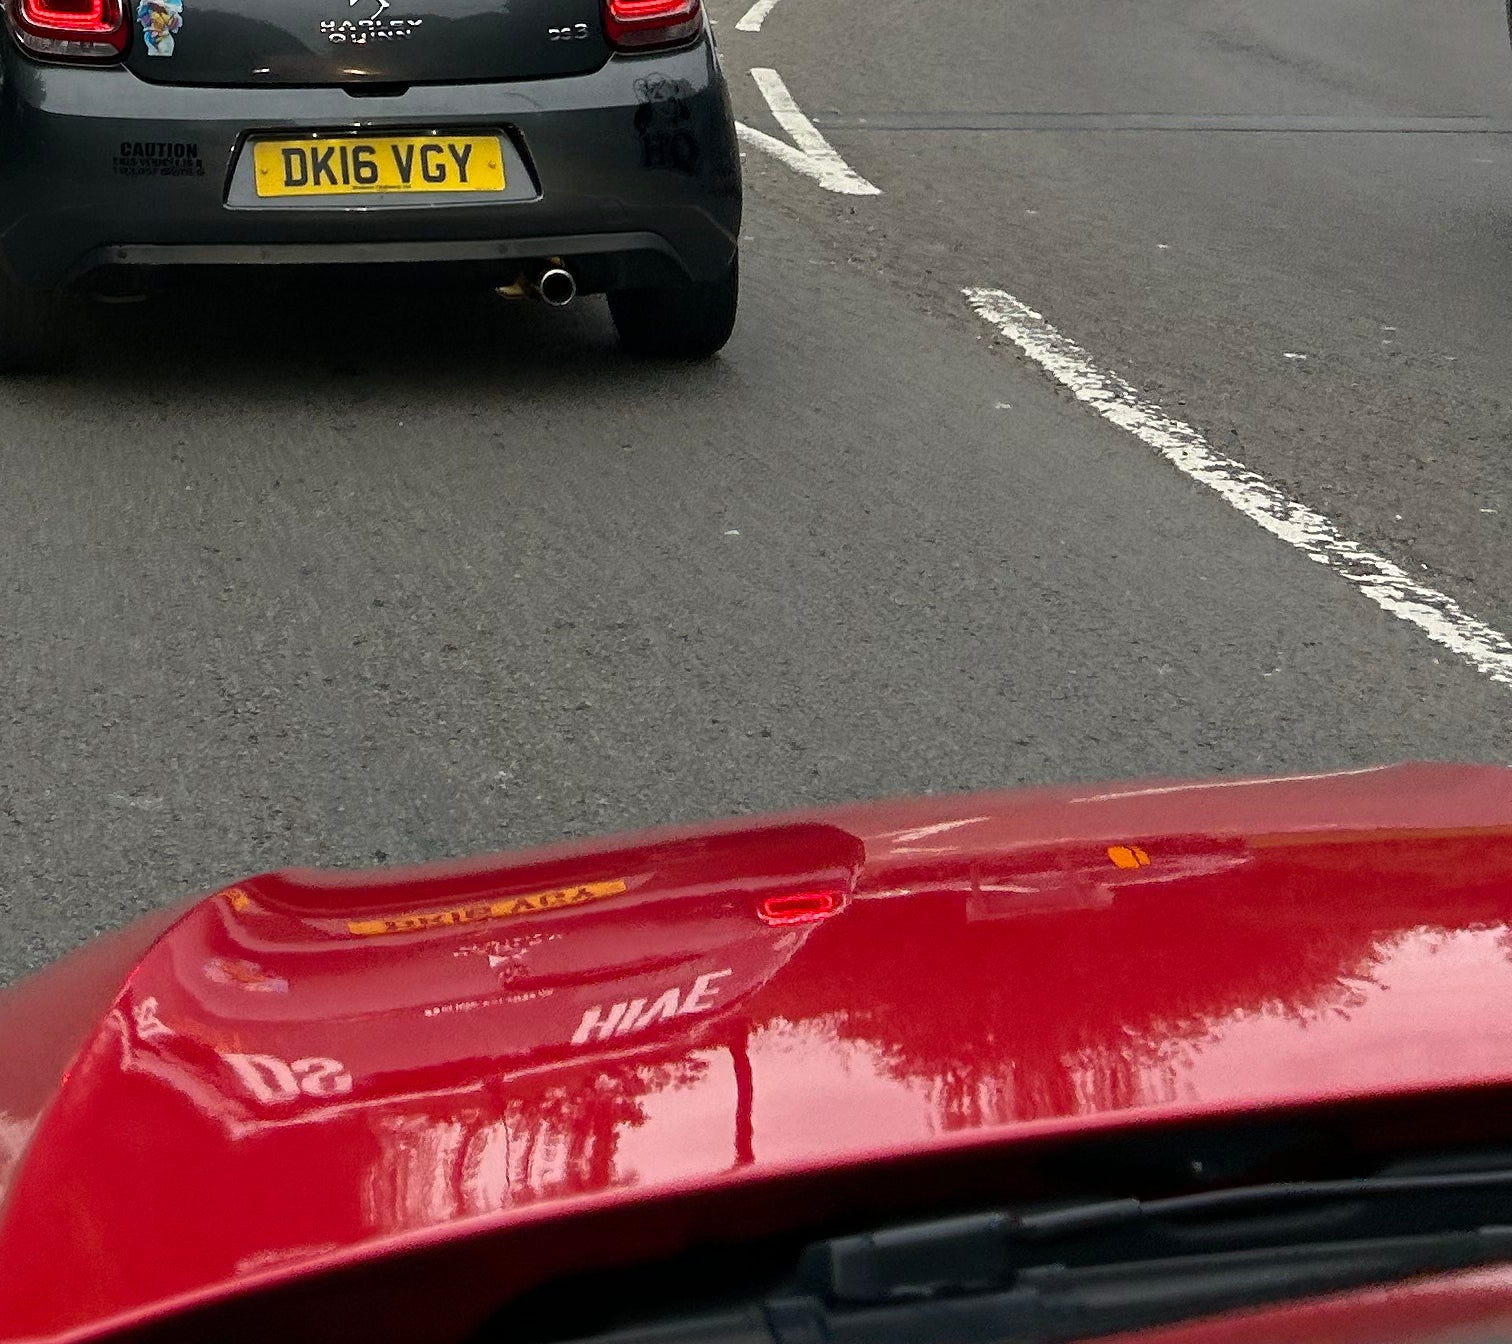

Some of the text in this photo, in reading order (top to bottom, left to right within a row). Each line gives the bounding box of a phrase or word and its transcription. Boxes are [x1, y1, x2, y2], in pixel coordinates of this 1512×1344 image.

[319, 19, 423, 33] HARLEY
[120, 141, 198, 159] CAUTION
[281, 143, 472, 187] DK16 VGY
